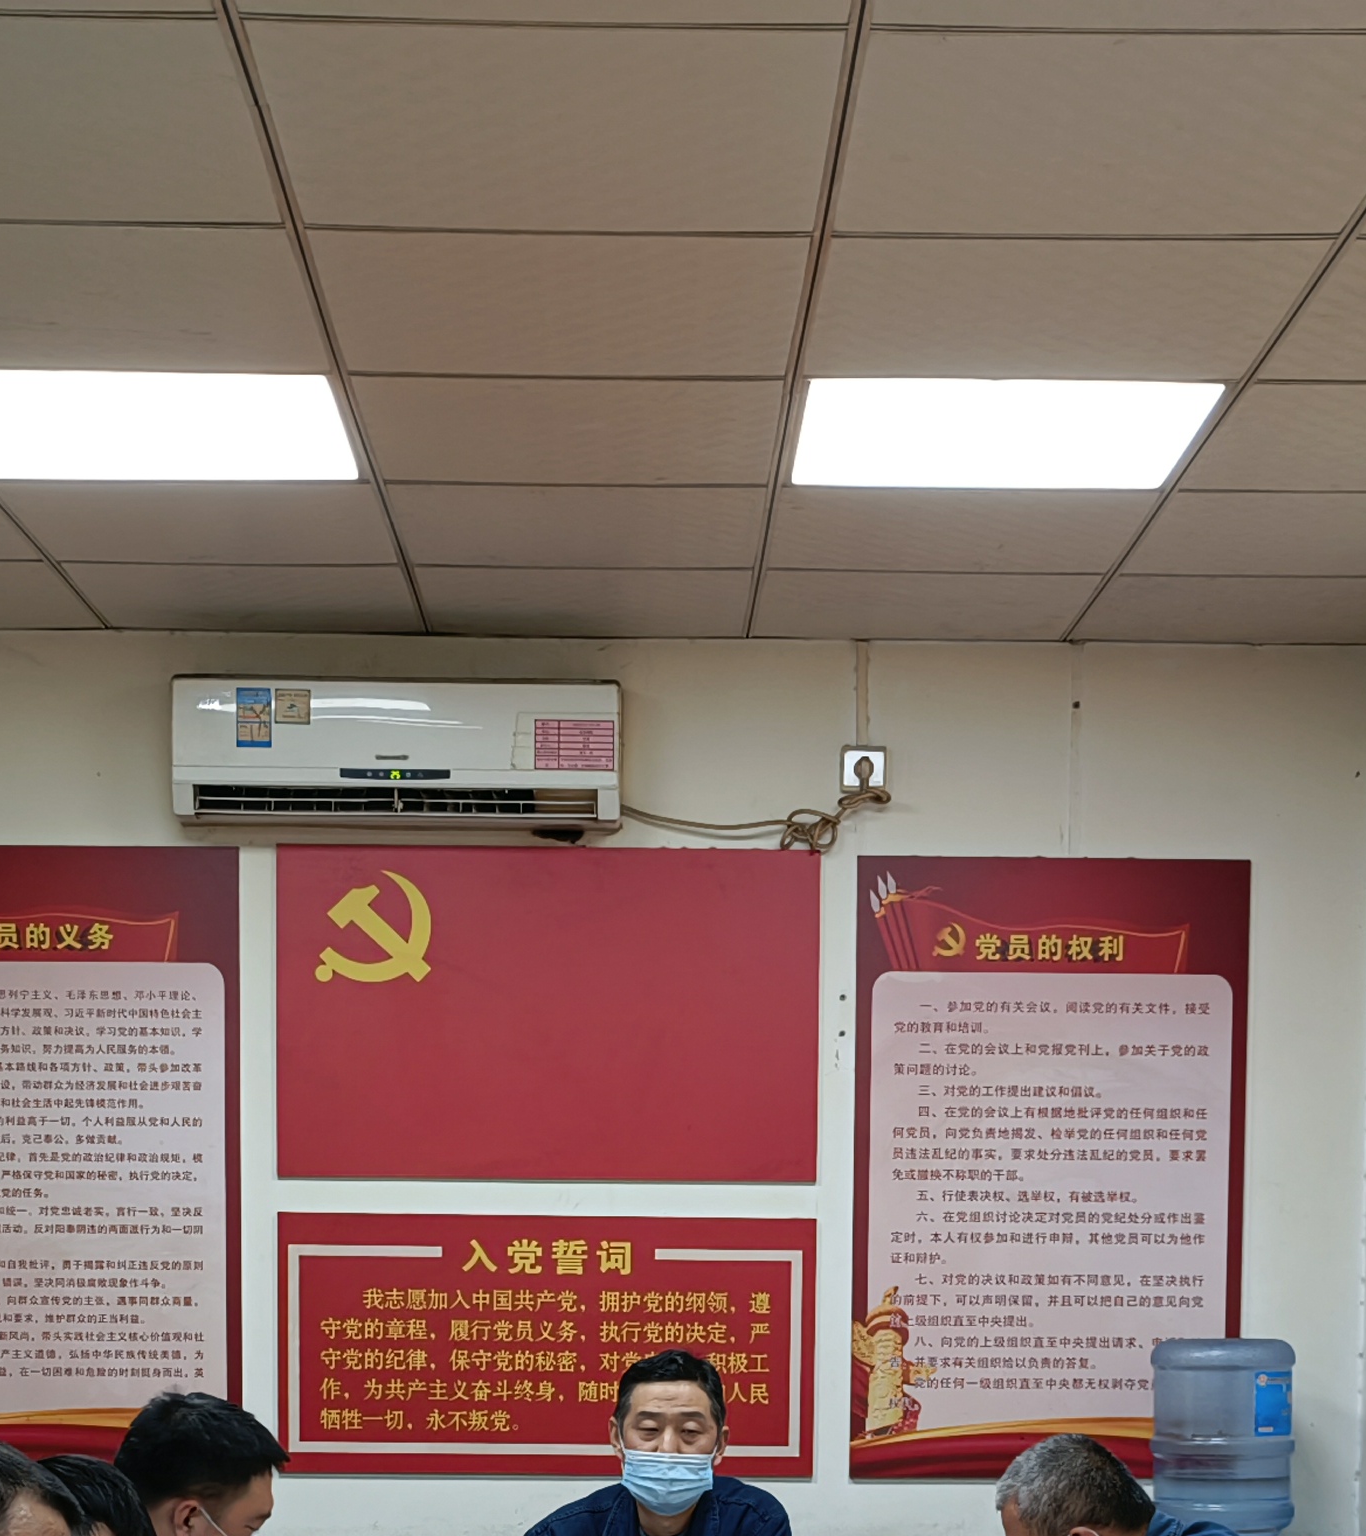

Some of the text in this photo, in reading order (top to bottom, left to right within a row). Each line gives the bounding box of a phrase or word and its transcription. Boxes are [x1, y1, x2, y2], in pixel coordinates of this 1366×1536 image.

[975, 934, 1125, 962] 党员的权利
[461, 1239, 632, 1275] 入党誓词
[362, 1287, 772, 1315] 我志愿加入中国共产党，拥护党的纲领，遵
[320, 1318, 772, 1345] 守党的章程，履行党员义务，执行党的决定，严
[320, 1408, 523, 1432] 牺牲一切，永不叛党。
